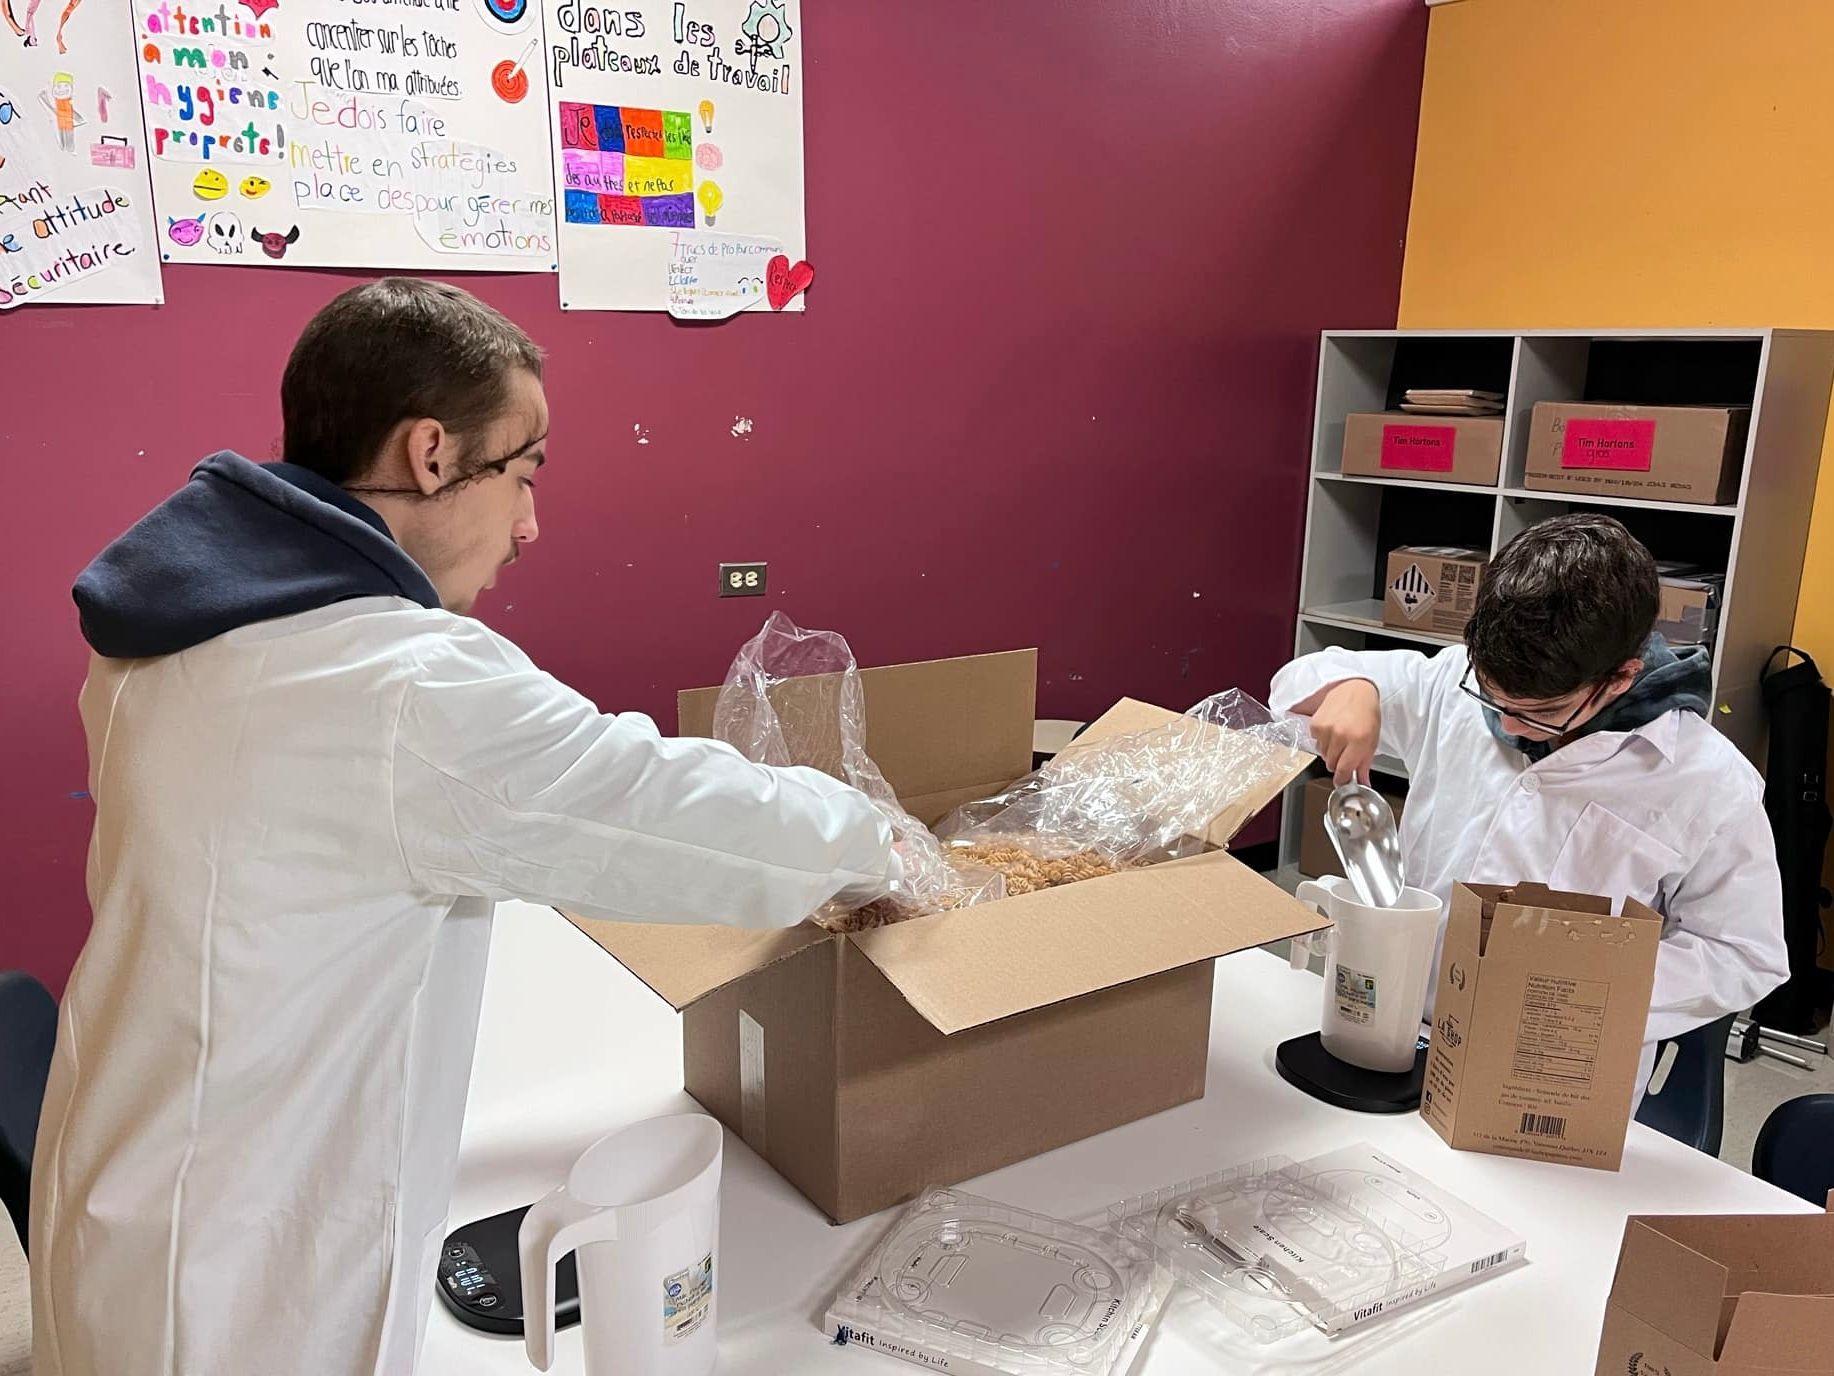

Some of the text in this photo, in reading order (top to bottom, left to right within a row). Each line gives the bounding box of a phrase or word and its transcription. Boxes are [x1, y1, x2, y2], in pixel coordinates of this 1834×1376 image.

[147, 2, 271, 38] attention
[558, 0, 715, 47] dans les
[377, 29, 398, 54] sur
[400, 24, 418, 57] les
[173, 48, 248, 69] mon
[553, 35, 789, 95] plateaux de travail
[291, 81, 445, 136] Je dois faire
[291, 140, 404, 178] mettre en
[294, 173, 364, 207] place
[529, 198, 553, 215] mes
[33, 190, 130, 239] attitude
[1393, 436, 1441, 447] Tim Hortons
[1578, 438, 1634, 449] Tim Hortons
[1353, 1302, 1383, 1321] Vitafit
[917, 1351, 929, 1363] by
[931, 1356, 949, 1368] Life
